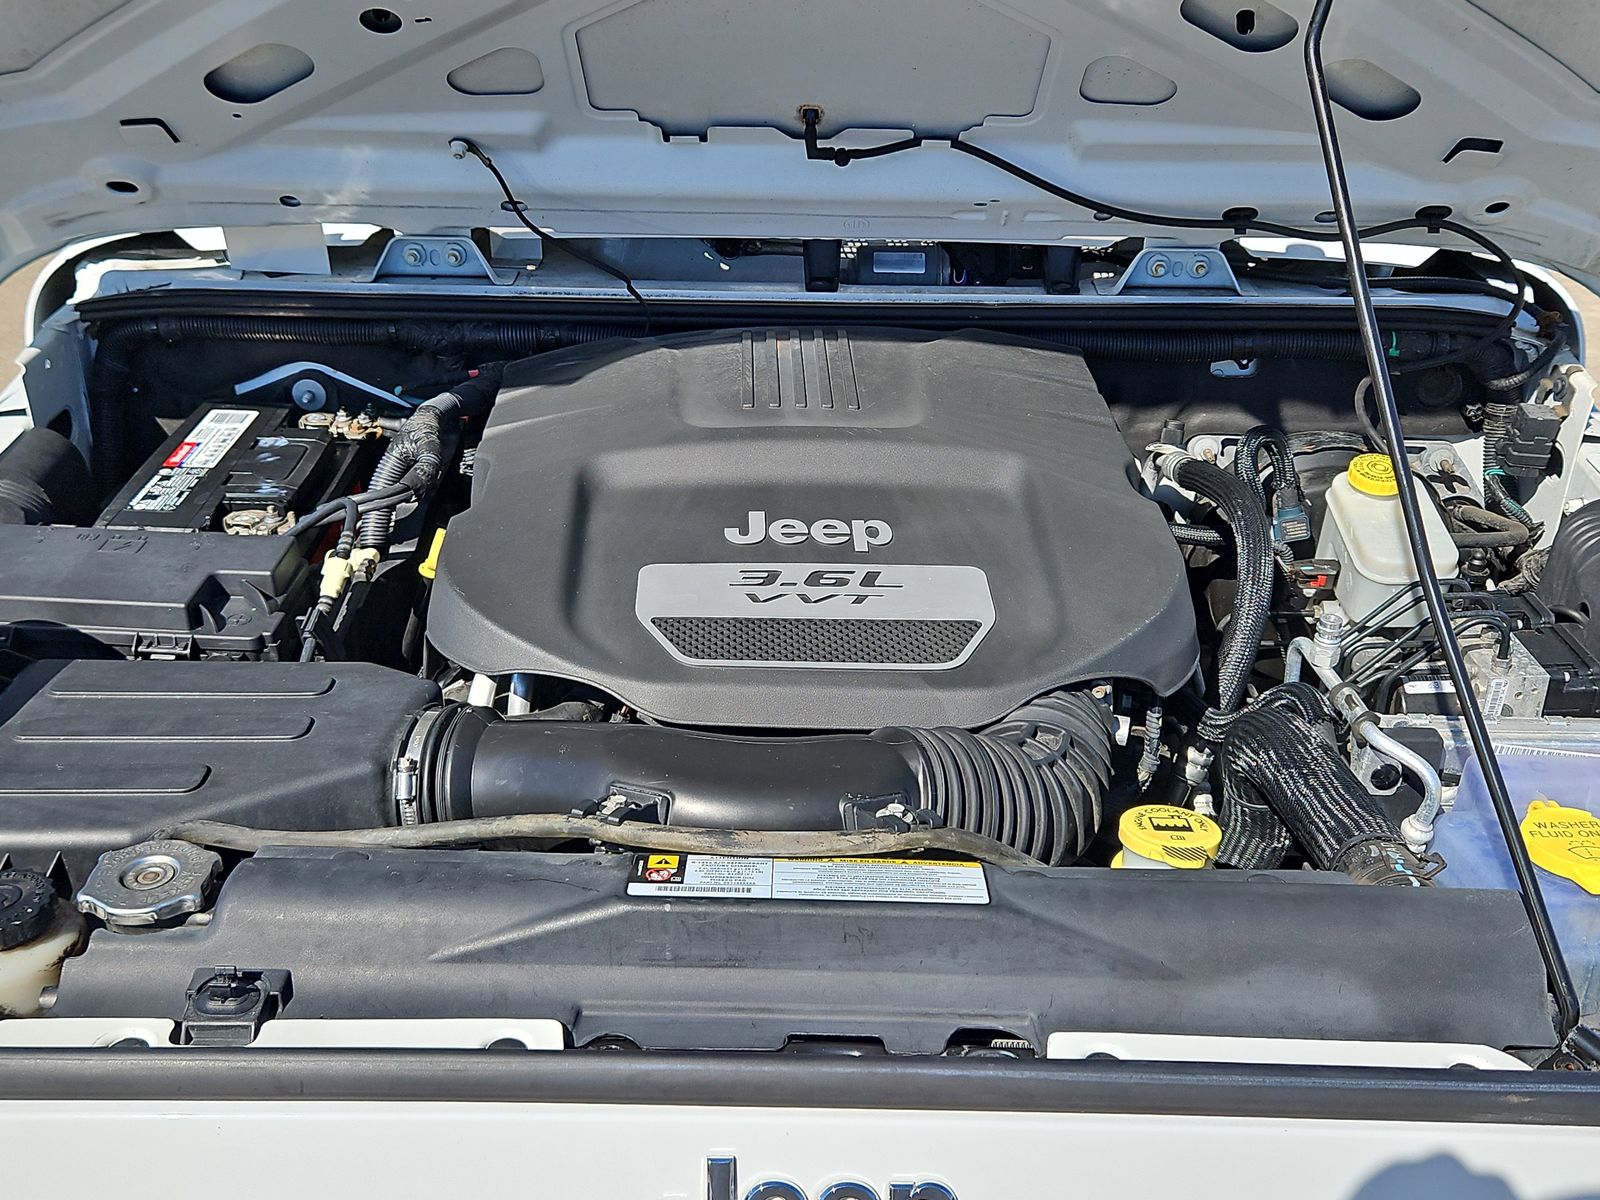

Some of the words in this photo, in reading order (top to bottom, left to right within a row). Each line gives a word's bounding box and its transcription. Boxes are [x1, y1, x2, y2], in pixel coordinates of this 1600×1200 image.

[724, 510, 894, 552] Jeep
[729, 569, 904, 588] 3.6L
[744, 592, 885, 605] VVT
[1144, 807, 1194, 818] COOLANT
[1533, 821, 1600, 829] WASHER
[1529, 830, 1574, 838] FLUID
